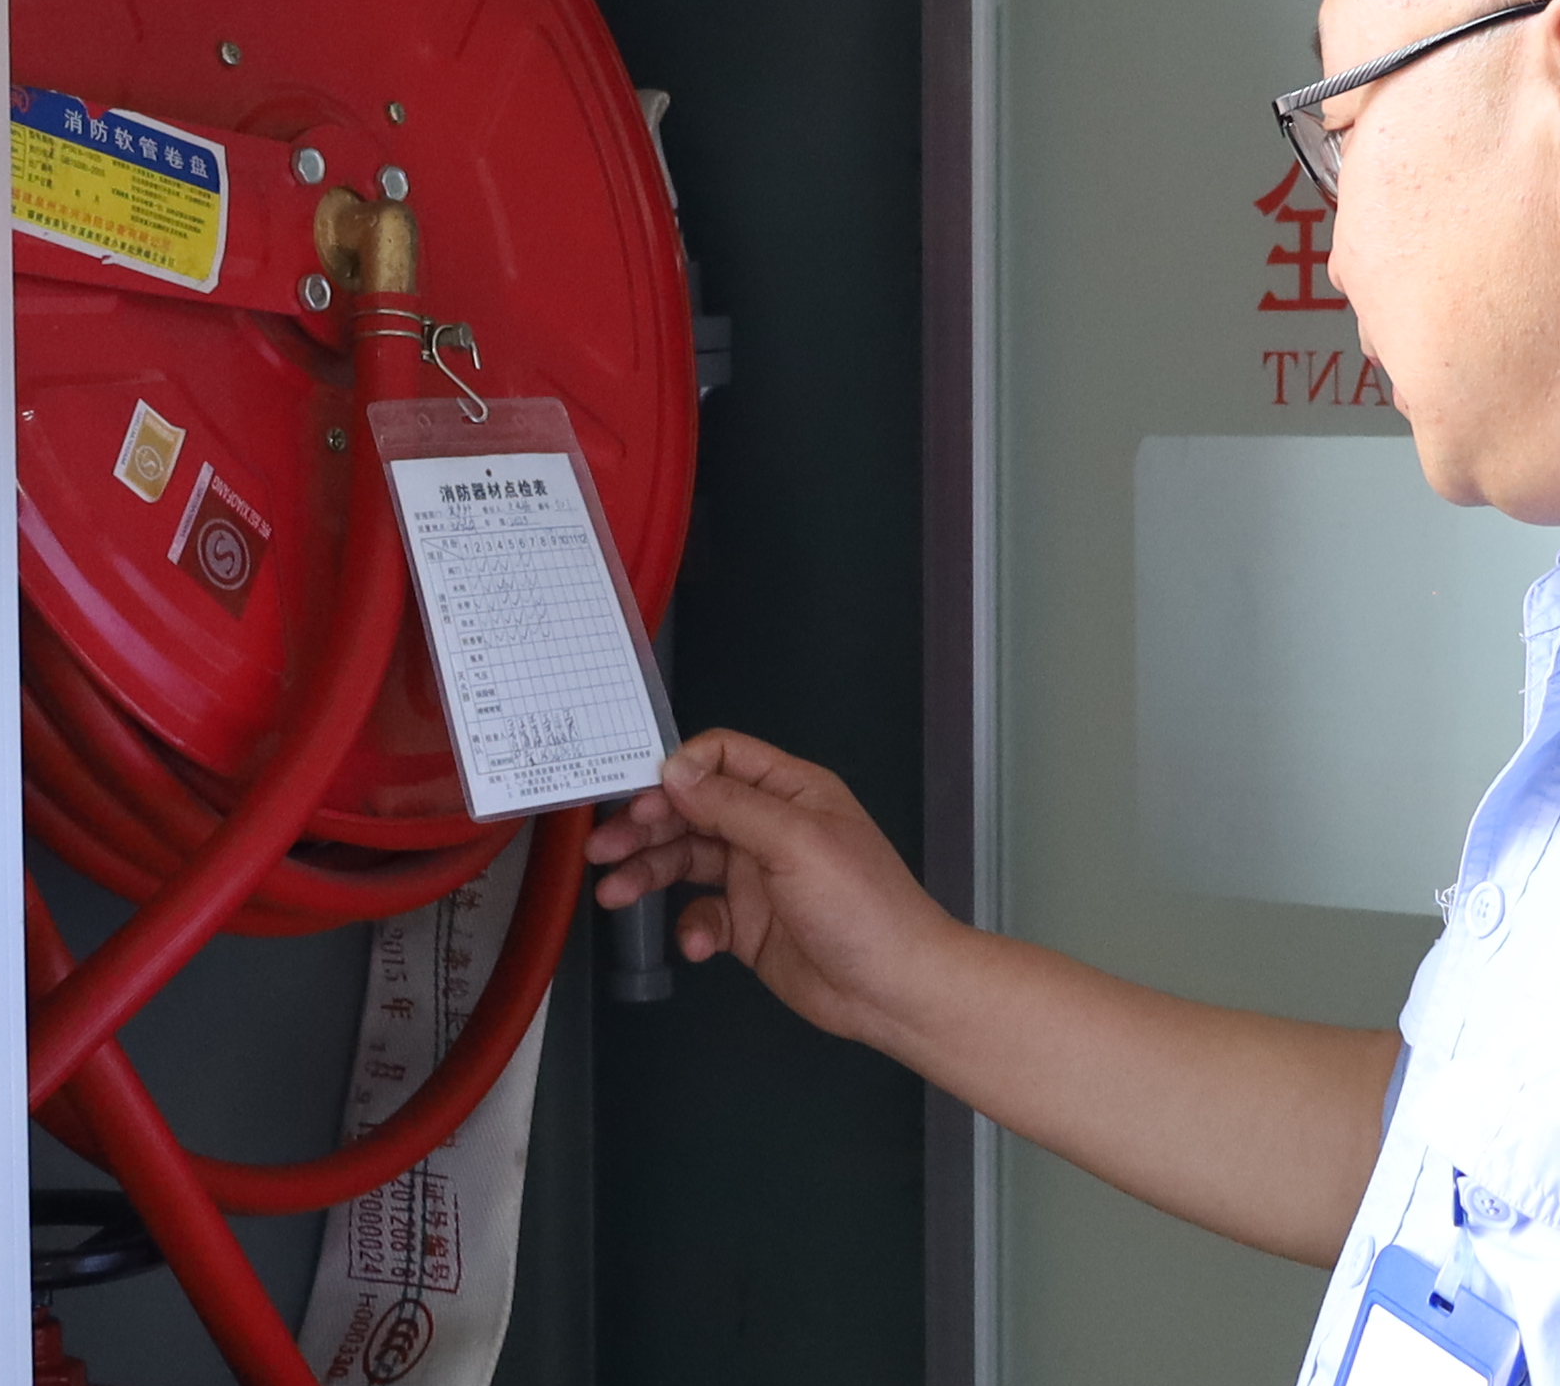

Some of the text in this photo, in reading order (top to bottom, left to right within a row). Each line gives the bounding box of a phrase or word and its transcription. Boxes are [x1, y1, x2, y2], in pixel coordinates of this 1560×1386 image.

[64, 108, 209, 179] 消防软管卷盘
[438, 479, 549, 504] 消防器材点检表
